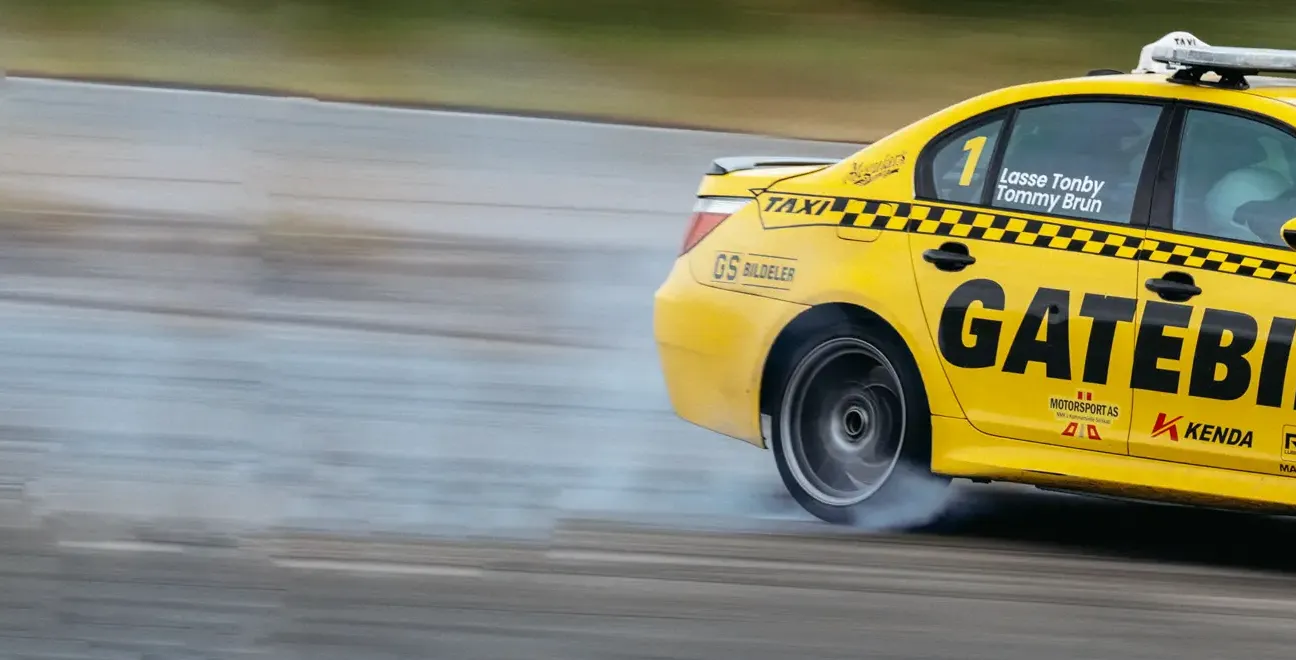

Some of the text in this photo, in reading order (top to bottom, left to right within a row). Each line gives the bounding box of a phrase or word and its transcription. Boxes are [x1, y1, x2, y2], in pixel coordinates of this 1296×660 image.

[959, 136, 987, 186] 1
[1000, 168, 1105, 198] Lasse Tonby
[764, 197, 832, 215] TAXI
[997, 185, 1102, 213] Tommy Brun
[714, 253, 796, 282] GS BILDELER
[1050, 398, 1119, 417] MOTORSPORT AS
[1184, 422, 1253, 448] KENDA
